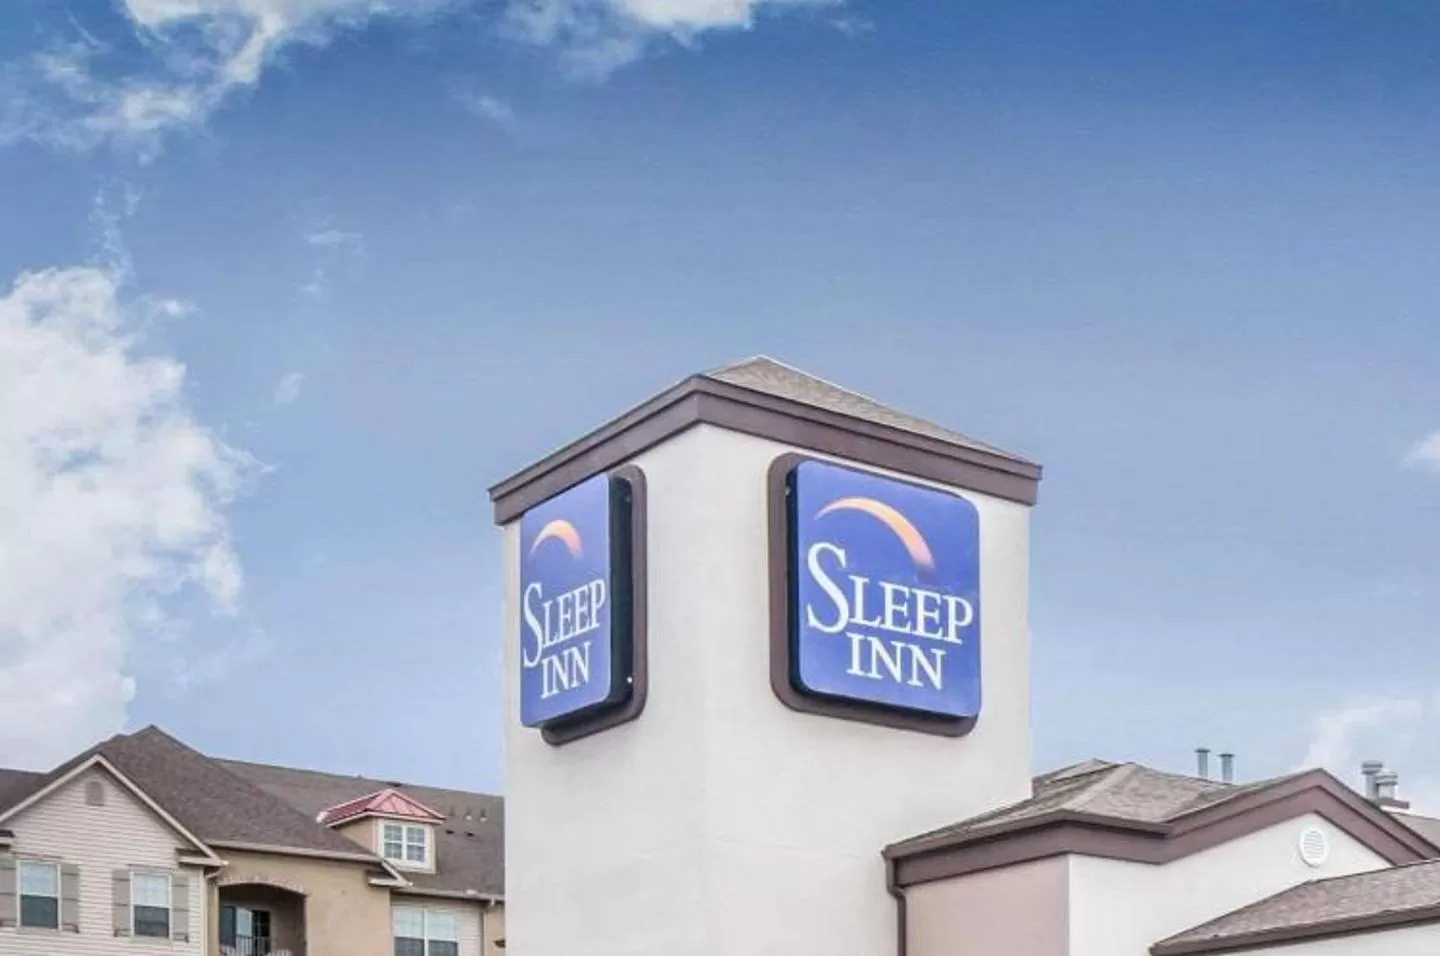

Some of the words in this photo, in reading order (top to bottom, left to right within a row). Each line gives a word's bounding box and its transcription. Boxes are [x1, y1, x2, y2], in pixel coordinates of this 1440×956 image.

[523, 578, 606, 668] SLEEP
[807, 541, 974, 646] SLEEP
[540, 641, 592, 700] INN
[845, 631, 946, 691] INN
